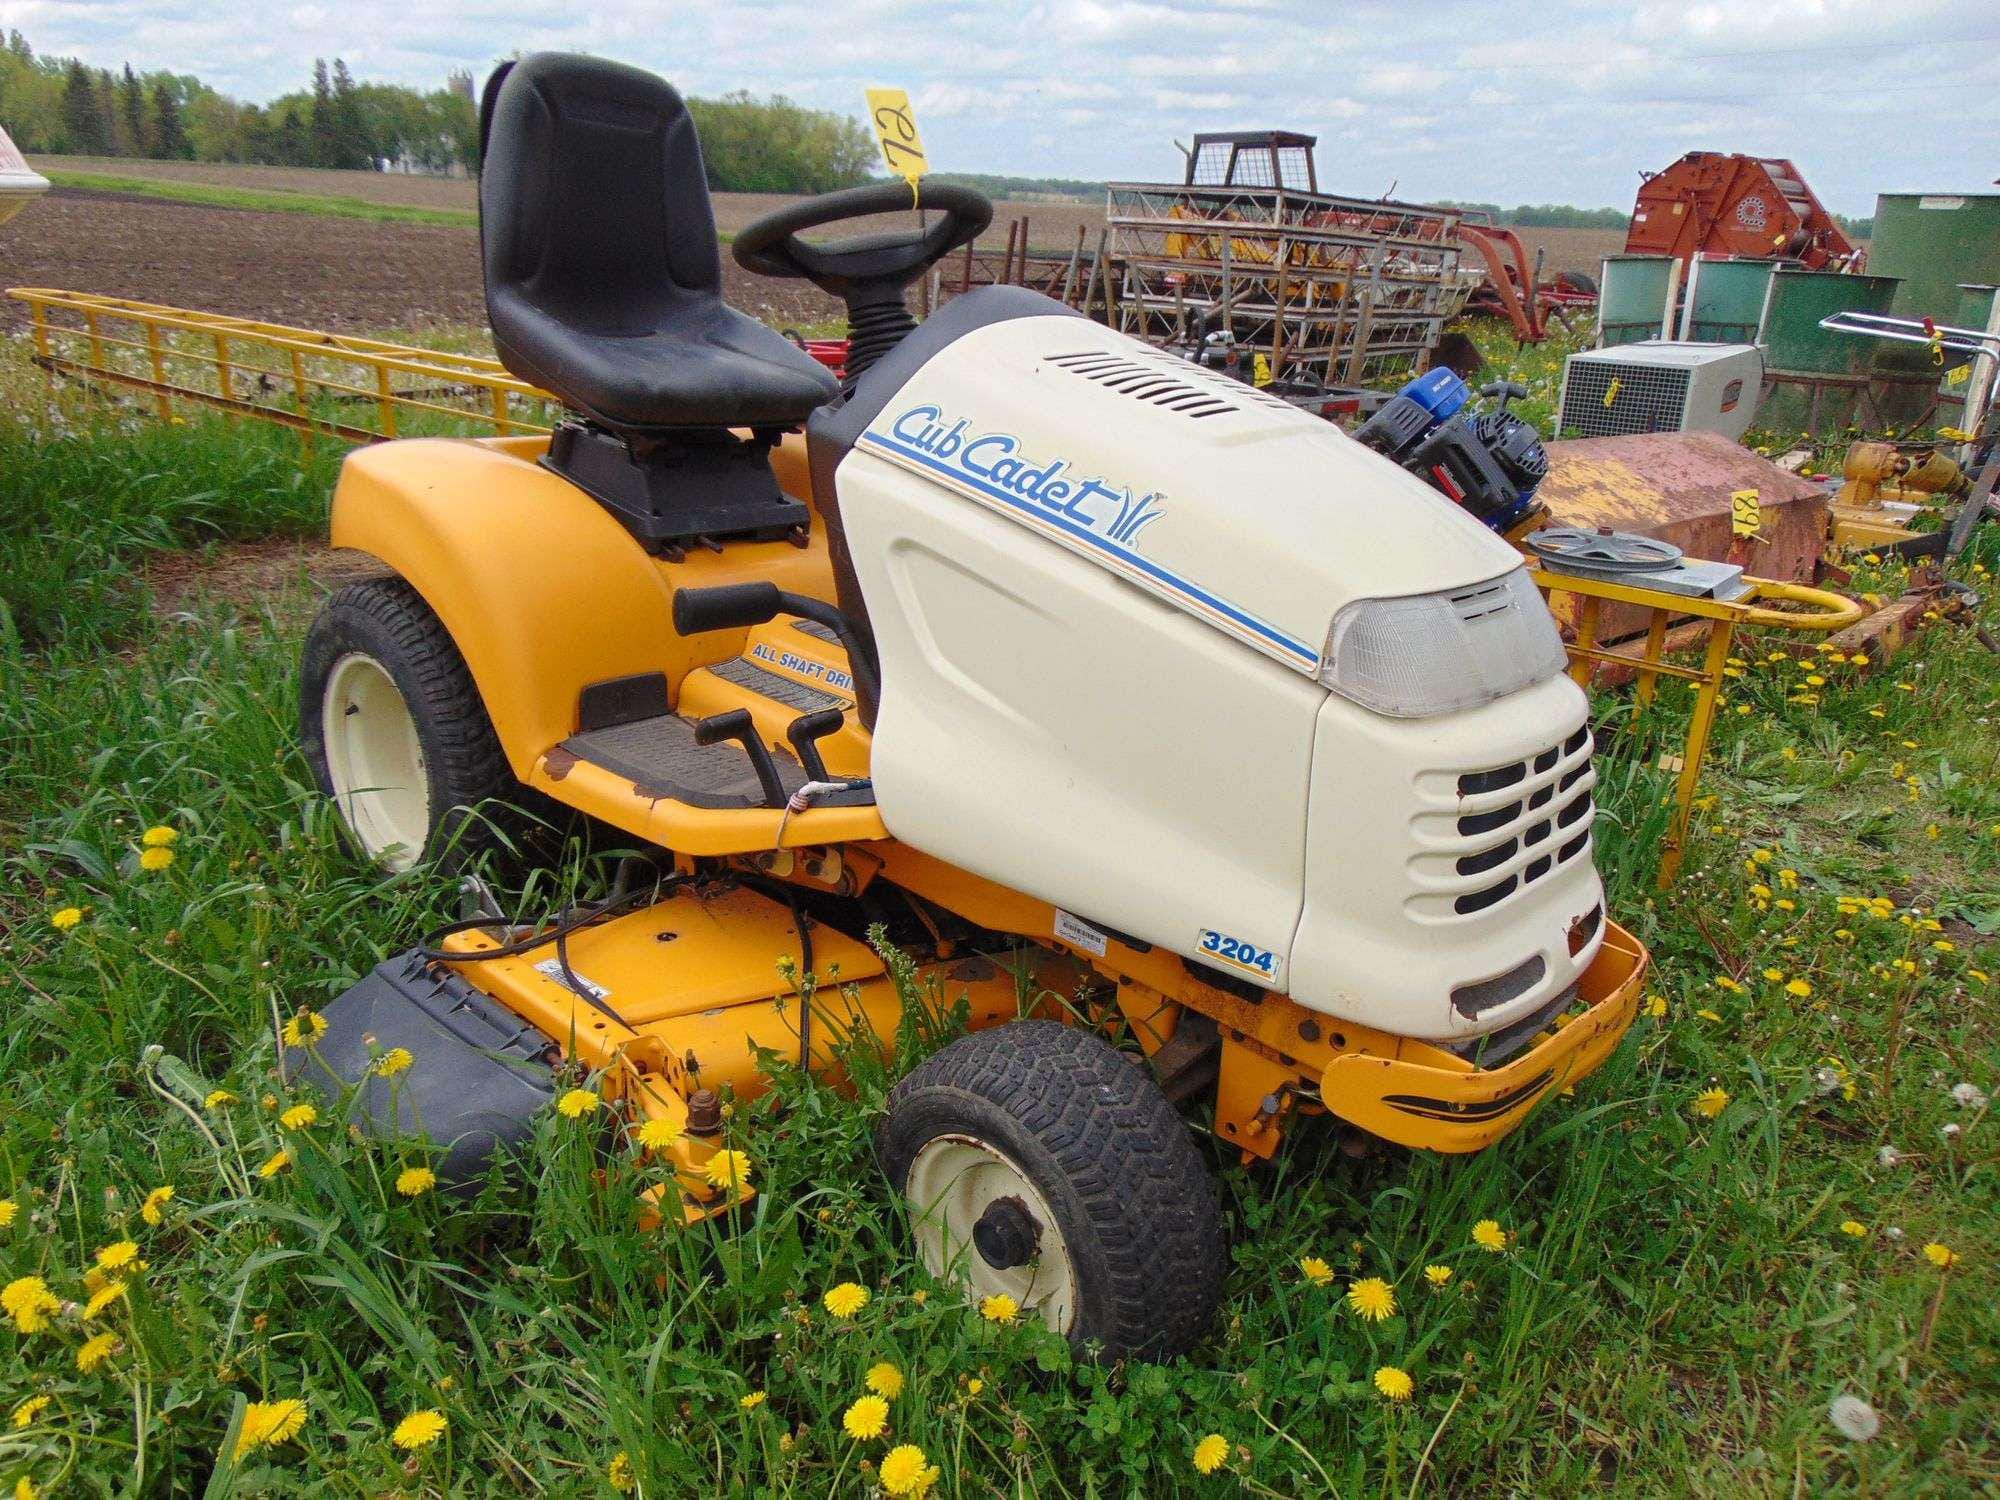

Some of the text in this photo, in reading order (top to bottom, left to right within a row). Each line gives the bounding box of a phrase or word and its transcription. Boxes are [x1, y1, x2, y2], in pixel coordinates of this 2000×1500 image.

[892, 405, 1121, 525] Cub Cadet
[1733, 496, 1760, 527] 68
[752, 644, 855, 690] ALL SHAFT DRI
[1203, 931, 1272, 971] 3204
